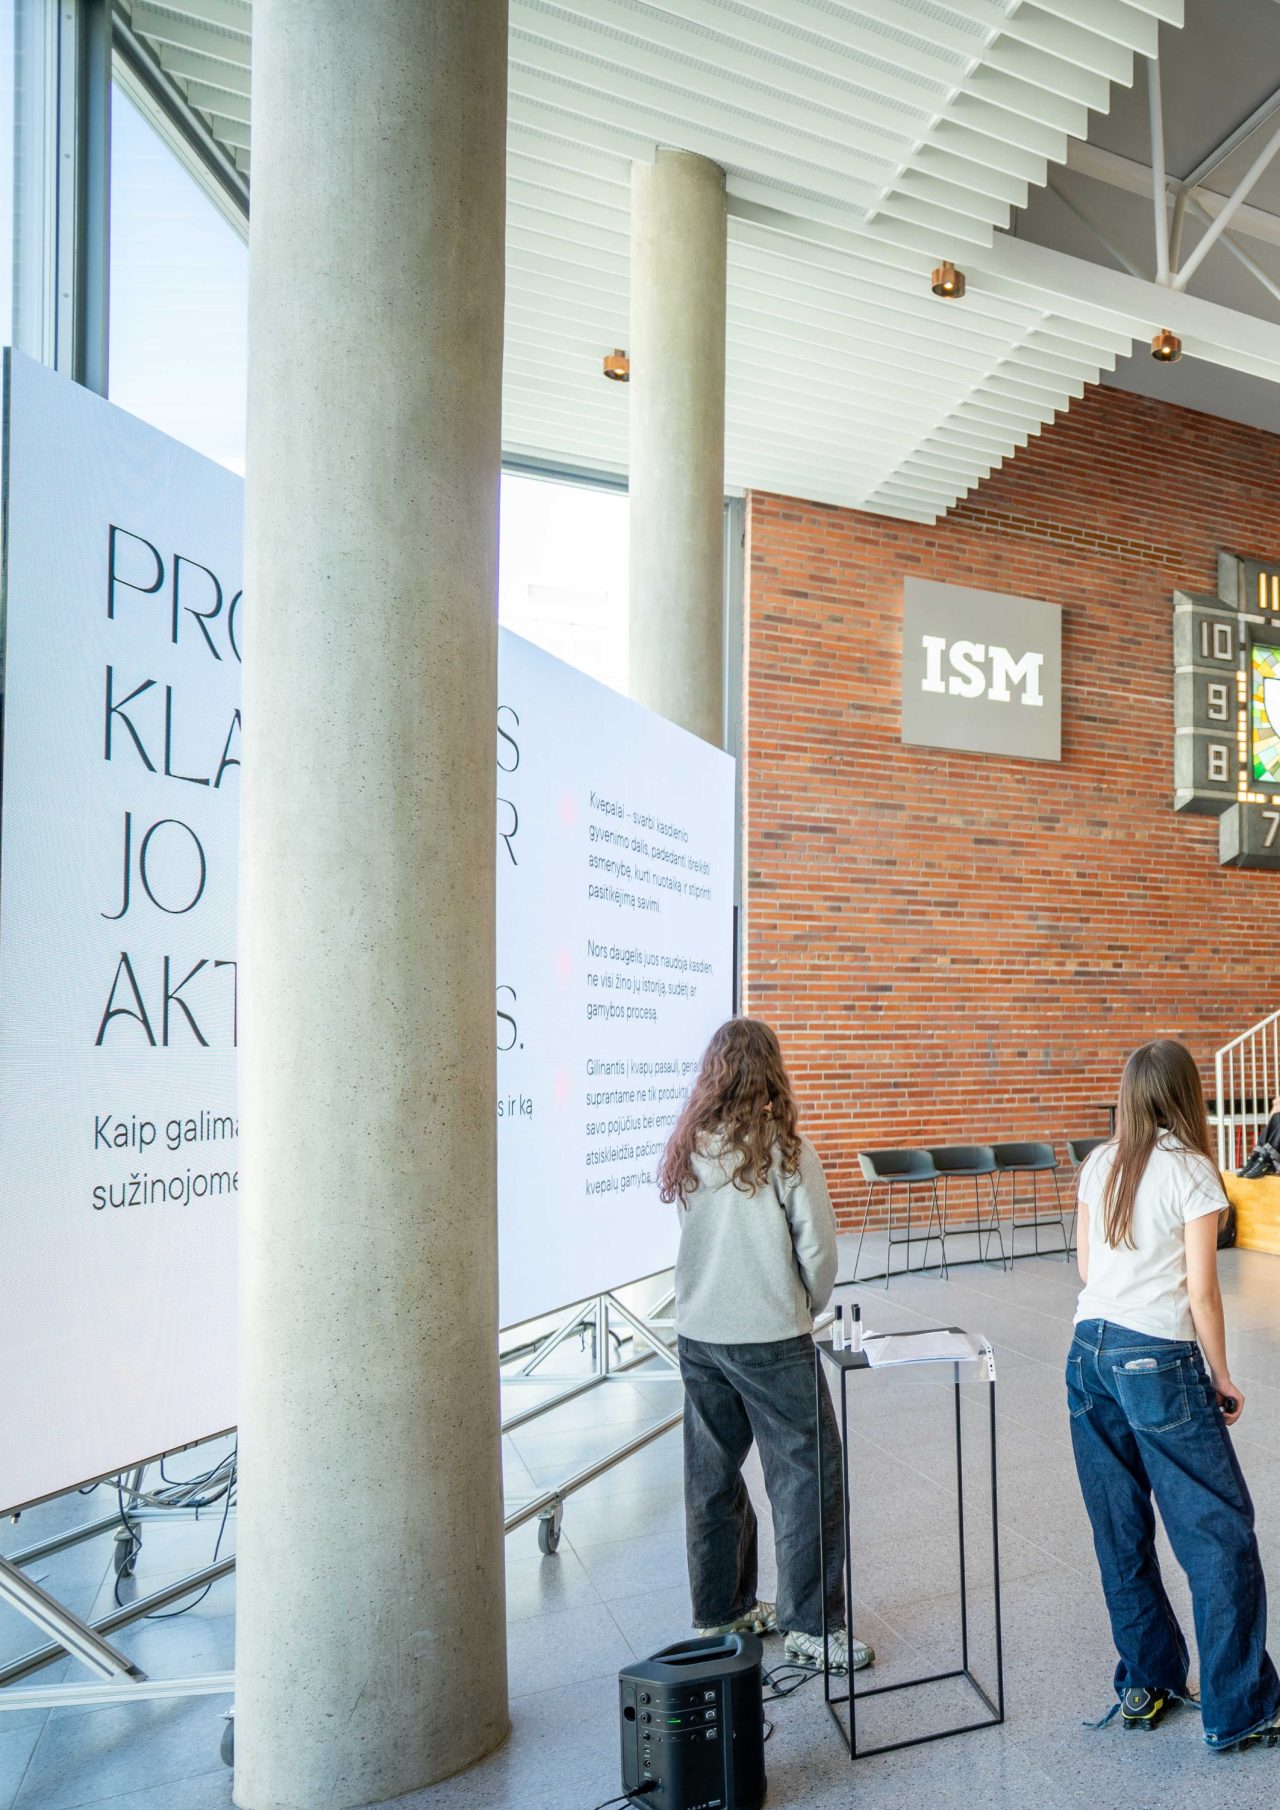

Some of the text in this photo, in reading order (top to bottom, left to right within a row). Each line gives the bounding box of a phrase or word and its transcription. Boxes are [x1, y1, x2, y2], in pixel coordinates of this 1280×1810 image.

[107, 523, 243, 664] PR
[1258, 572, 1280, 611] 11
[1201, 621, 1233, 661] 10
[921, 634, 1044, 707] ISM
[1207, 683, 1228, 721] 9
[1208, 743, 1229, 782] 8
[590, 790, 625, 819] Kvepalai
[589, 825, 629, 849] gyvenimo
[1261, 811, 1280, 847] 7
[101, 811, 207, 920] JO
[587, 938, 608, 960] Nors
[609, 944, 643, 966] daugelis
[587, 973, 598, 987] ne
[600, 971, 614, 989] visi
[615, 972, 632, 990] žino
[586, 1001, 625, 1021] gamybos
[586, 1089, 635, 1108] suprantame
[636, 1089, 647, 1102] ne
[648, 1085, 657, 1101] tik
[94, 1114, 157, 1153] Kaip
[166, 1109, 238, 1150] galim
[508, 1094, 516, 1116] ir
[519, 1093, 533, 1120] ką
[586, 1119, 606, 1135] savo
[642, 1113, 655, 1129] bei
